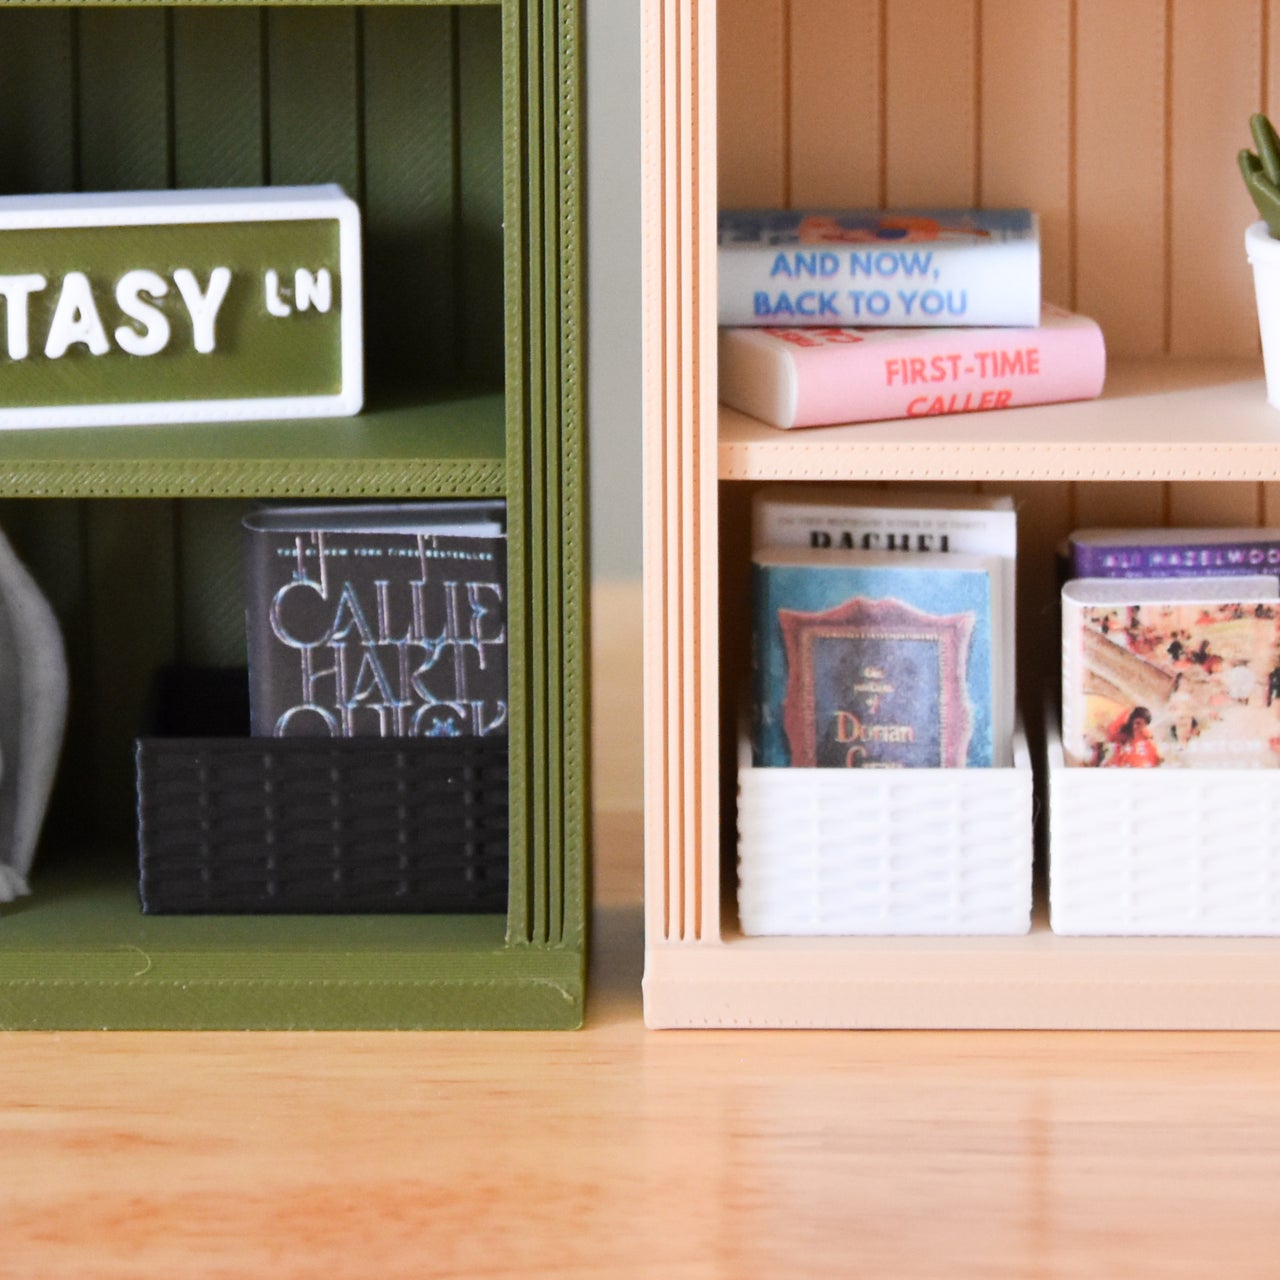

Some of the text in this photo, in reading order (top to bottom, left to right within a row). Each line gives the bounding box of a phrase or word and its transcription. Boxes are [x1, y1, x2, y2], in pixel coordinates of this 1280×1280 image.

[770, 251, 941, 281] AND NOW,
[264, 267, 332, 317] LN
[752, 289, 969, 318] BACK TO YOU
[885, 347, 1041, 387] FIRST-TIME
[906, 389, 1013, 418] CALLER
[833, 710, 916, 743] Dorian
